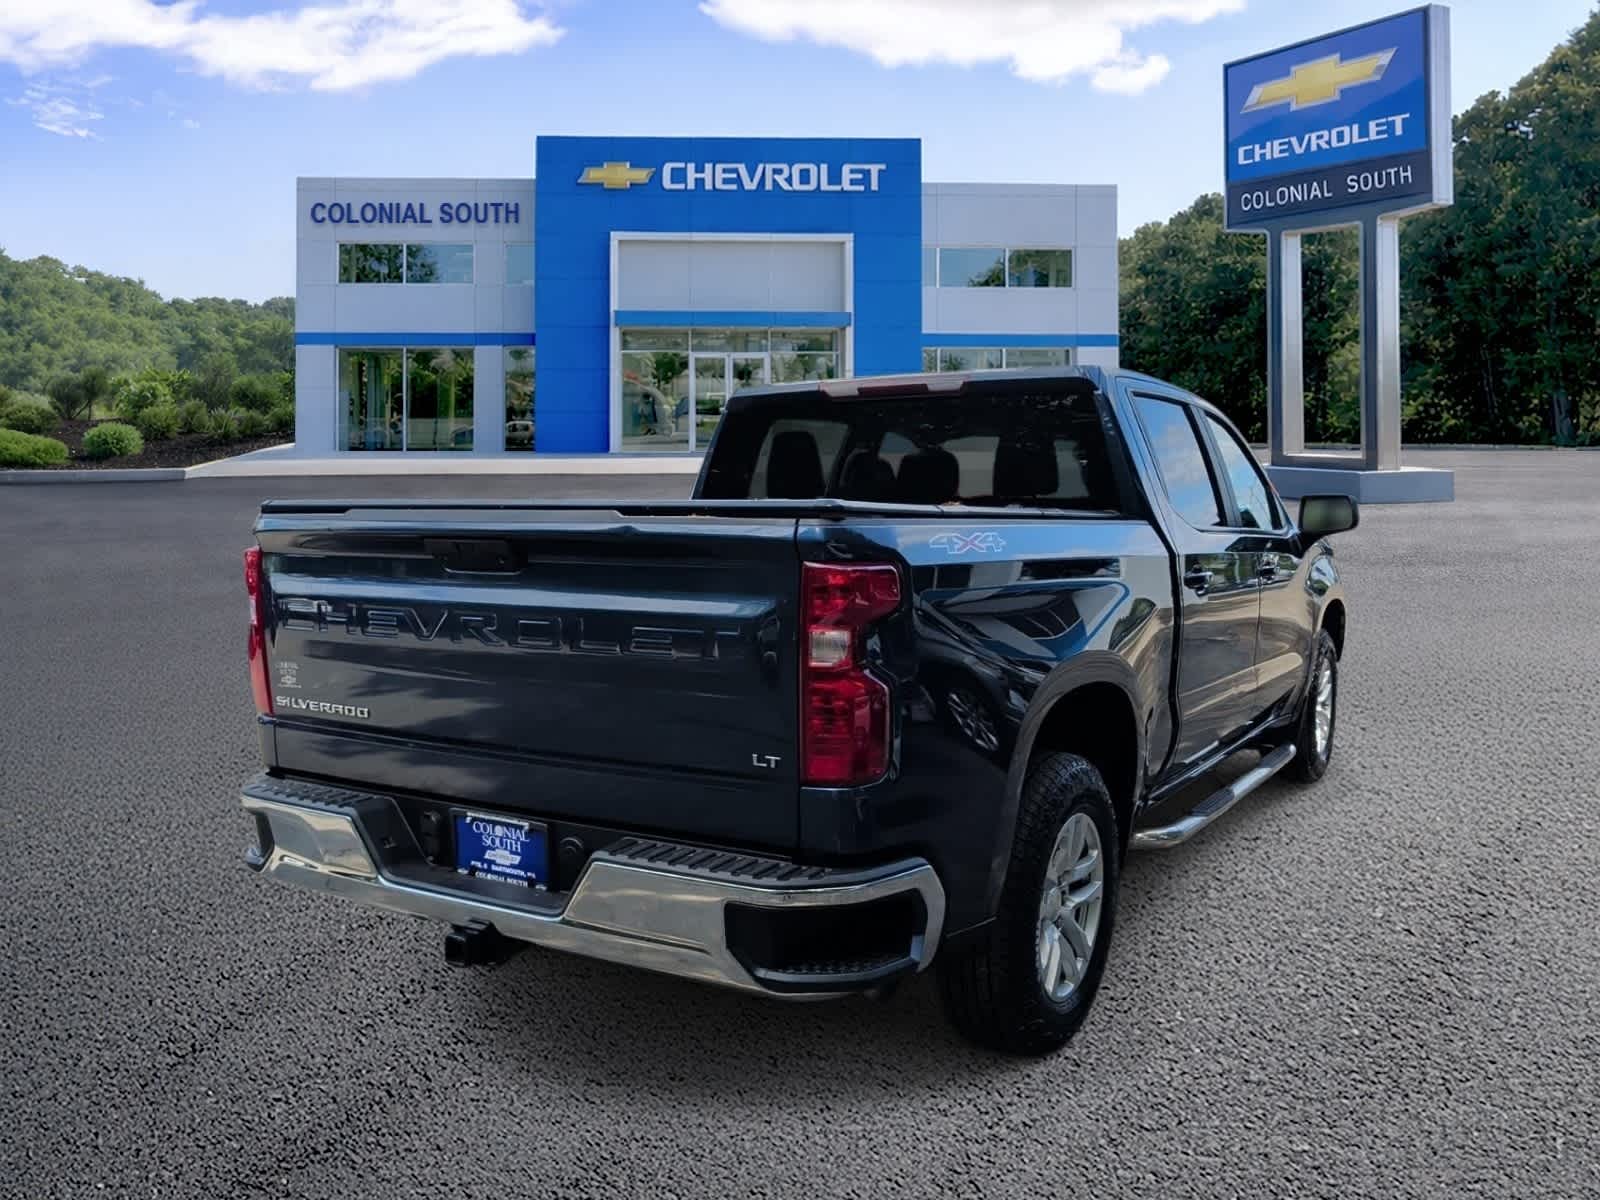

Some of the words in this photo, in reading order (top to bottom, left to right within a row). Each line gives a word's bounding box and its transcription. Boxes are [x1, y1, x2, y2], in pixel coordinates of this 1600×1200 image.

[1237, 113, 1410, 165] CHEVROLET
[661, 161, 887, 192] CHEVROLET
[1240, 180, 1333, 211] COLONIAL
[1346, 165, 1412, 193] SOUTH
[310, 202, 433, 224] COLONIAL
[439, 202, 520, 224] SOUTH
[279, 597, 741, 661] CHEVROLET
[275, 695, 370, 719] SILVERADO
[752, 753, 782, 768] LT
[472, 821, 530, 842] COLONIAL
[482, 833, 521, 853] SOUTH
